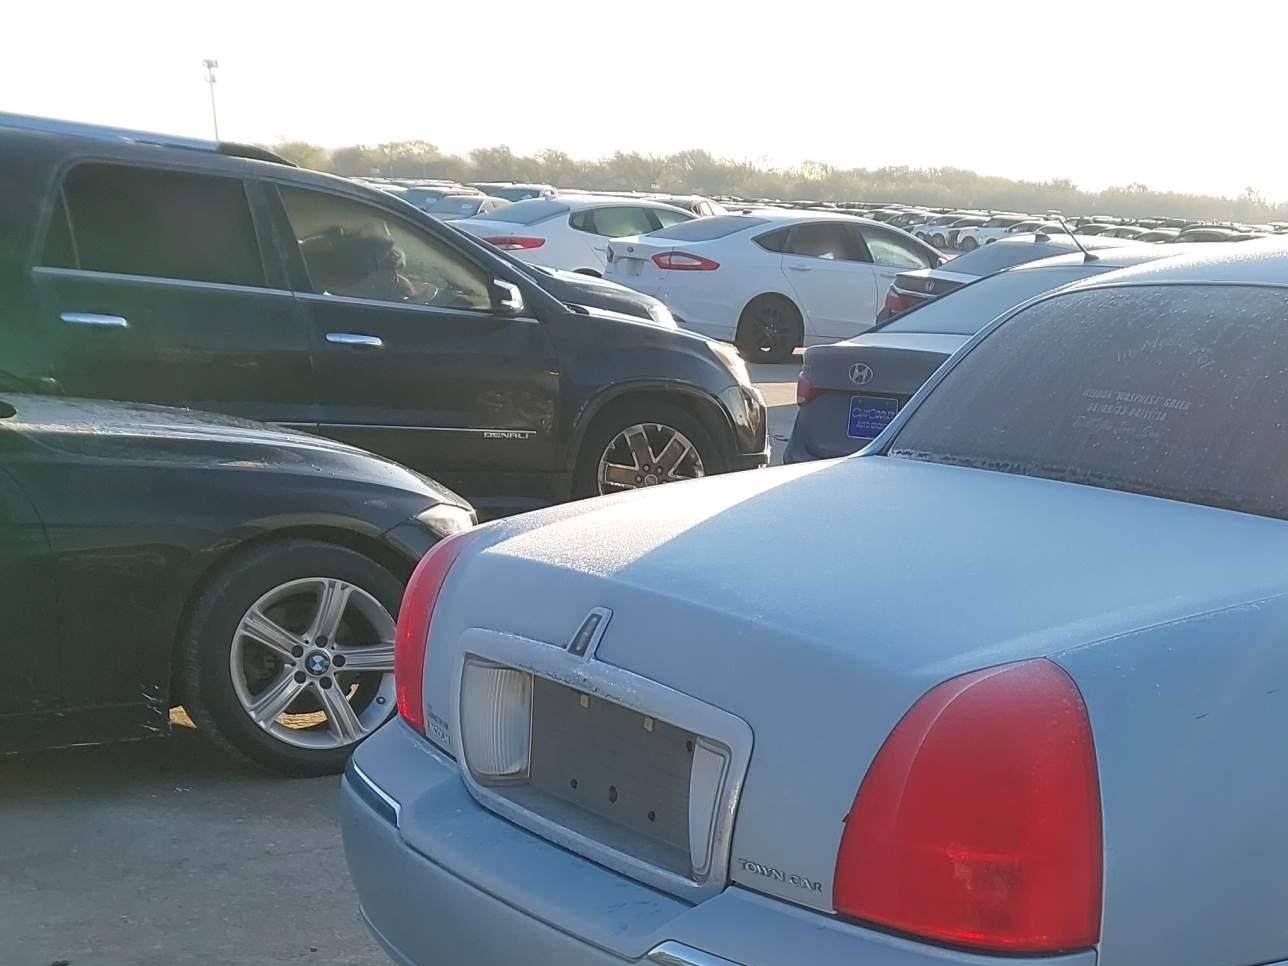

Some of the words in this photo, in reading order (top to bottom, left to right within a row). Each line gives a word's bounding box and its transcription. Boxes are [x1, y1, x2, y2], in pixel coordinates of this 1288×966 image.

[483, 431, 529, 439] DENALI
[738, 857, 786, 882] TOWN
[789, 875, 823, 894] CAR
